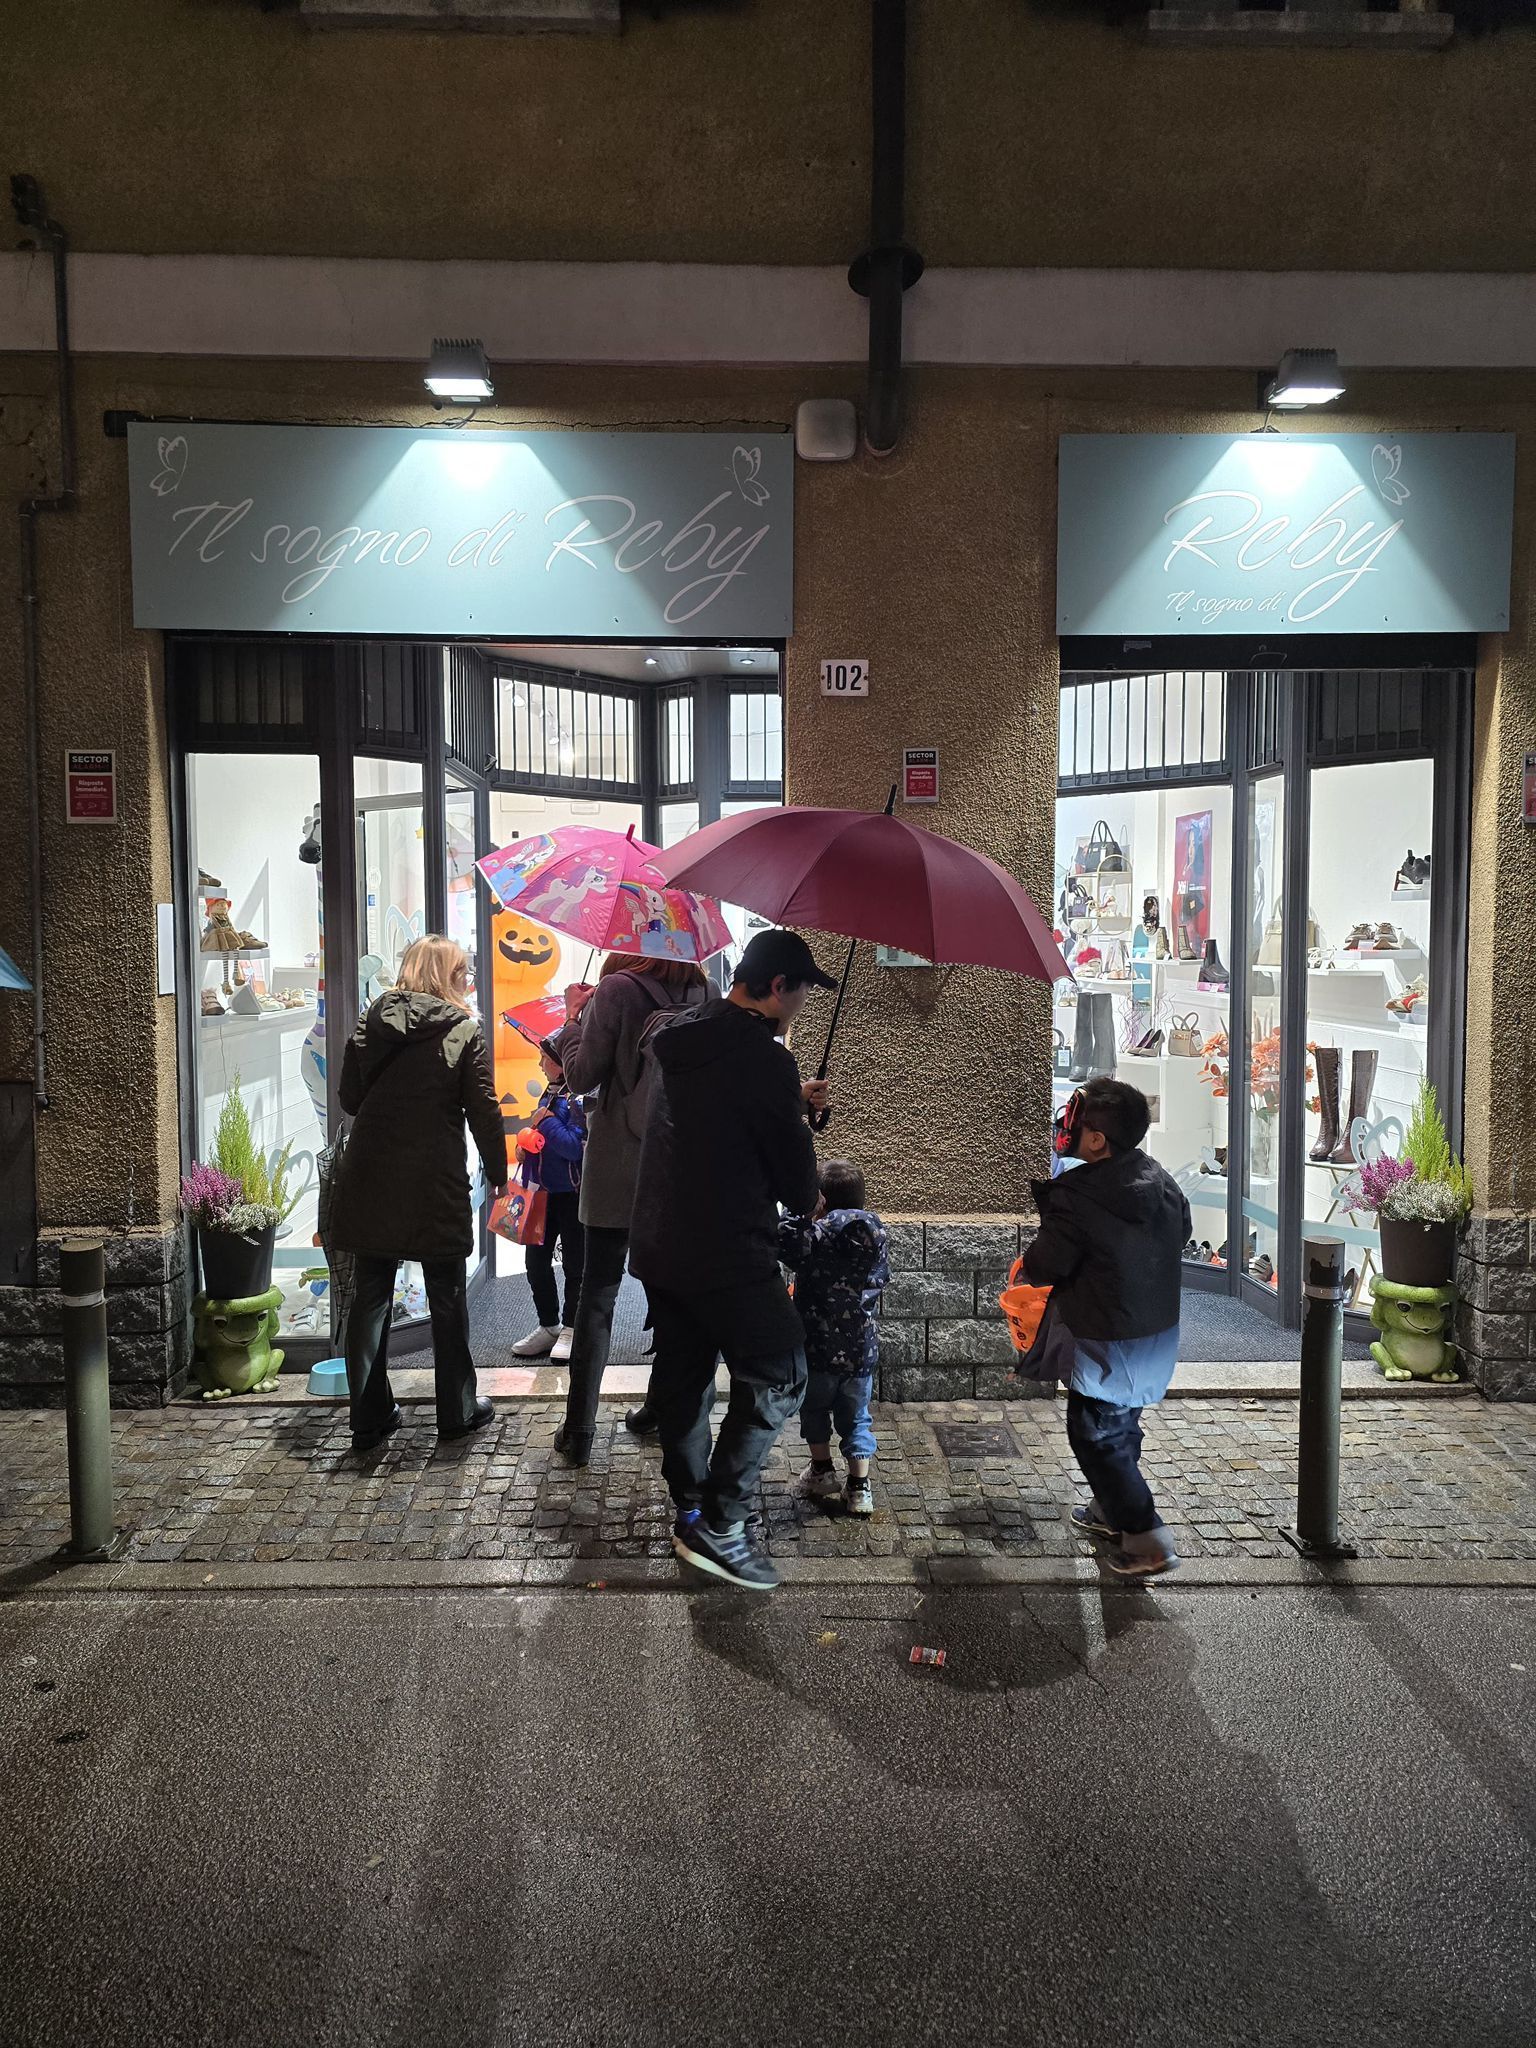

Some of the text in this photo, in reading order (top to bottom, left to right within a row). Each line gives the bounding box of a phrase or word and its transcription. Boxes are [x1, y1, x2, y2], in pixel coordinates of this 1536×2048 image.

[249, 523, 433, 604] sogno
[447, 508, 526, 569] di
[542, 491, 771, 624] Reby
[1163, 484, 1405, 623] Reby
[1192, 597, 1255, 625] sogno
[1257, 591, 1288, 612] di
[825, 664, 862, 691] 102
